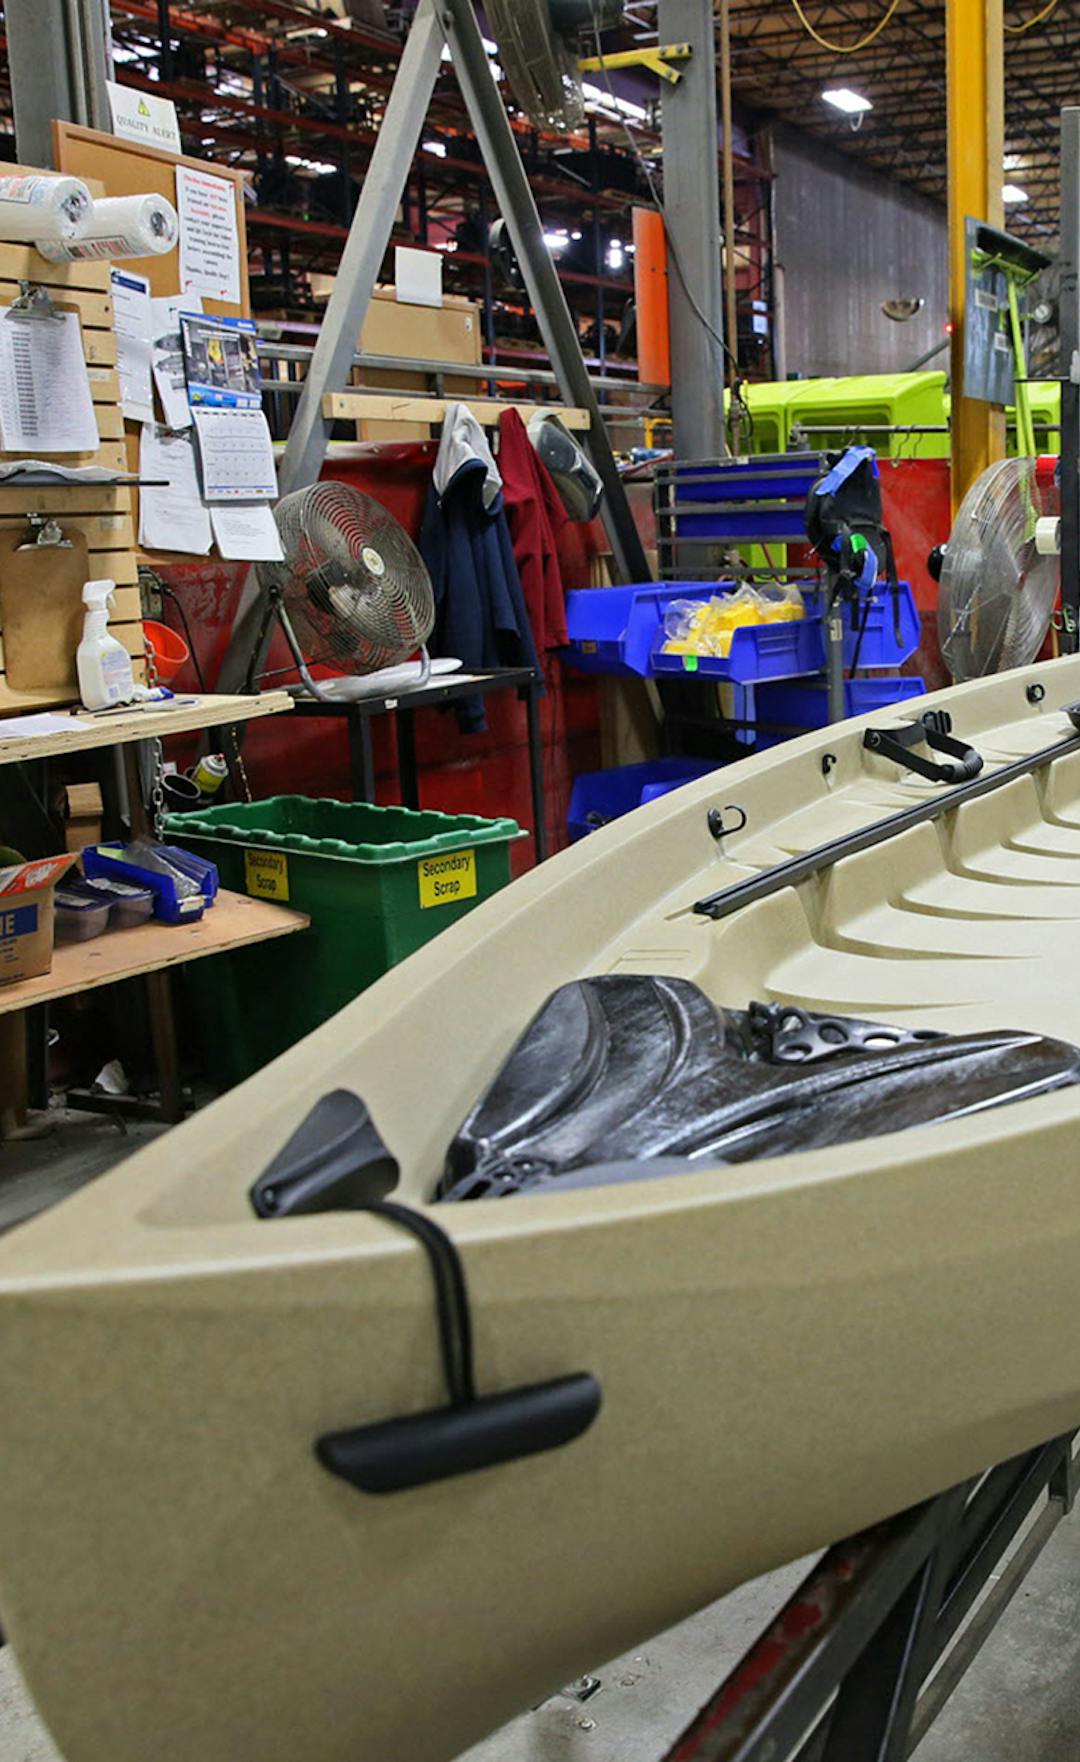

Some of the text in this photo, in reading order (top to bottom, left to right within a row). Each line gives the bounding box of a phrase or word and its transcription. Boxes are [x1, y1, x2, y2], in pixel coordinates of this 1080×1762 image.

[116, 115, 176, 140] QUALITY ALERT
[248, 852, 284, 875] Secondary
[423, 855, 471, 878] Secondary
[256, 873, 277, 892] Scrap
[433, 878, 461, 897] Scrap
